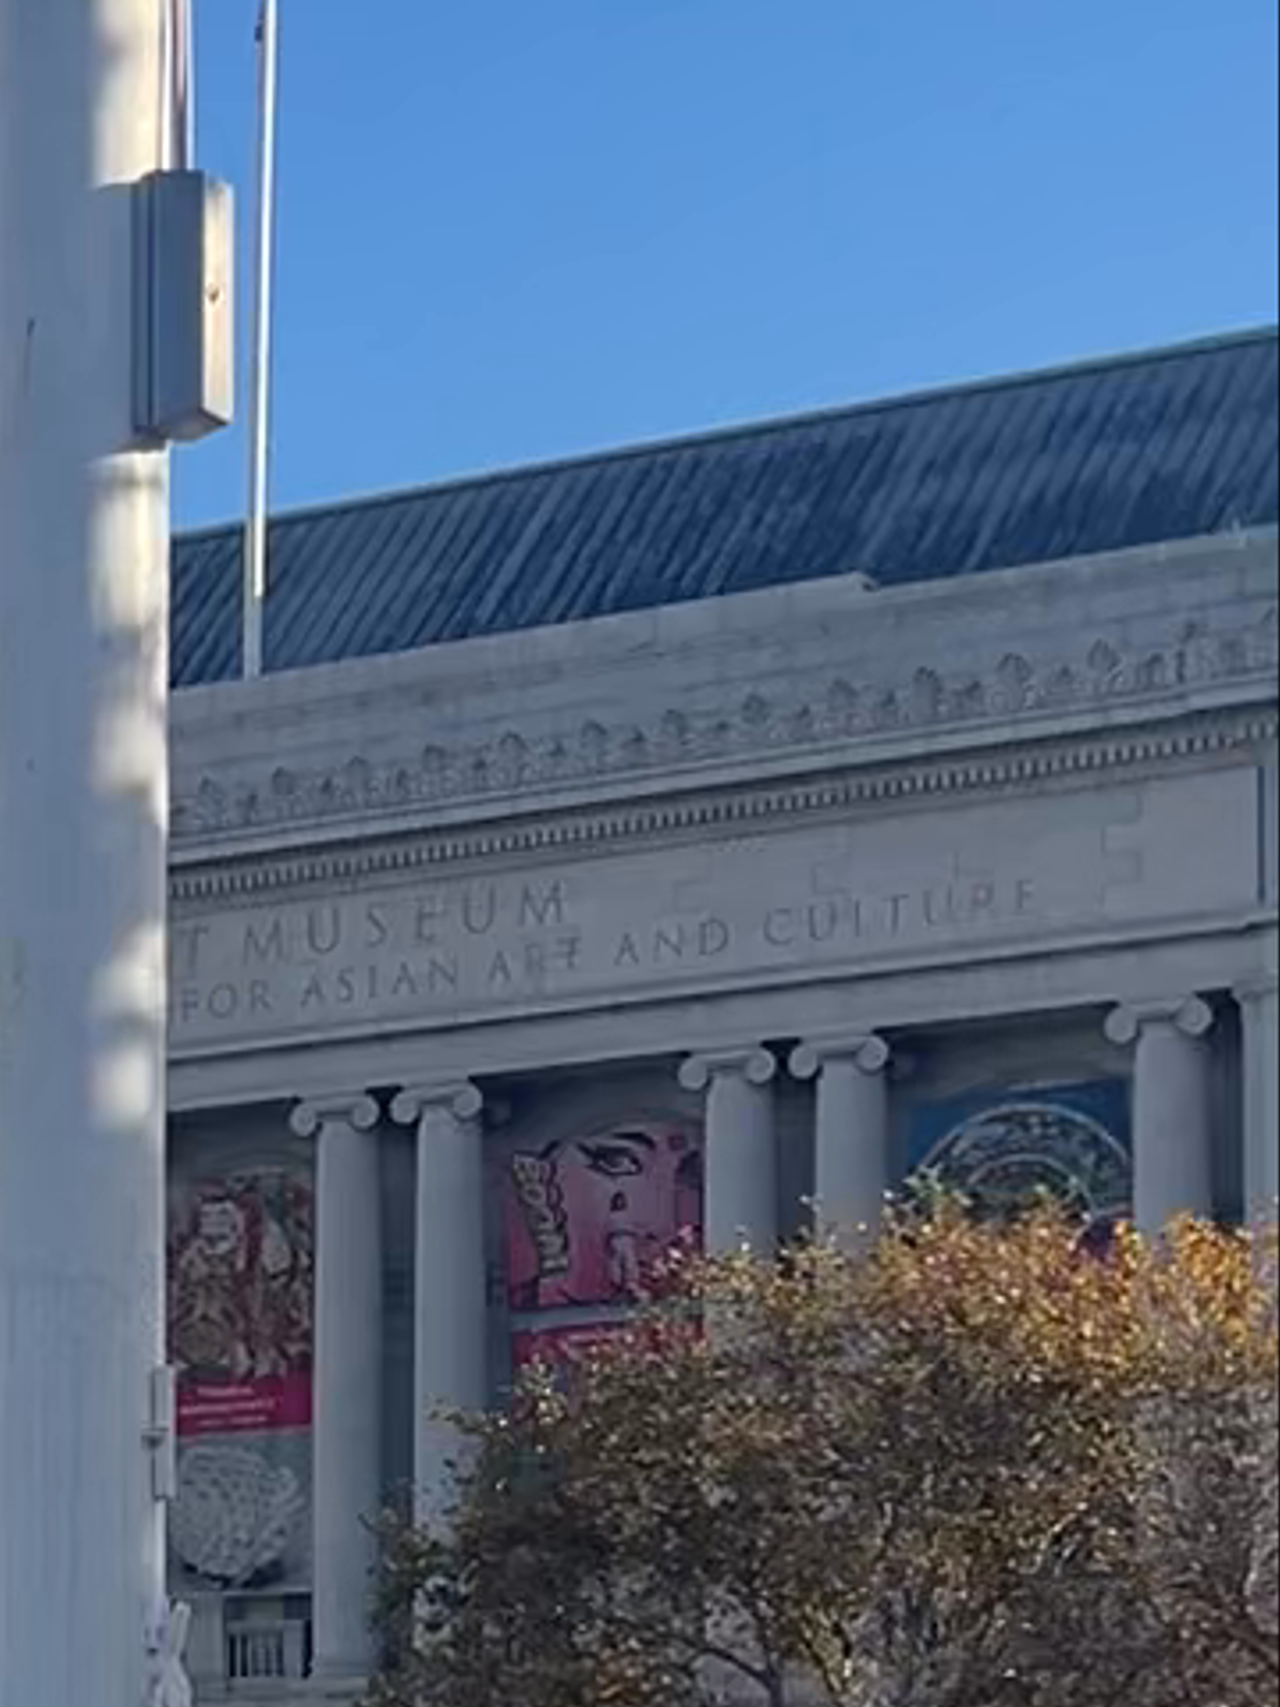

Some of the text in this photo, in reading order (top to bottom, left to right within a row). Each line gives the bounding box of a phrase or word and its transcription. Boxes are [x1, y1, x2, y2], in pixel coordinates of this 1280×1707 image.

[181, 979, 273, 1023] FOR
[300, 954, 460, 1008] ASIAN
[488, 934, 583, 983] ART
[614, 917, 730, 966] AND
[243, 879, 566, 967] MUSEUM
